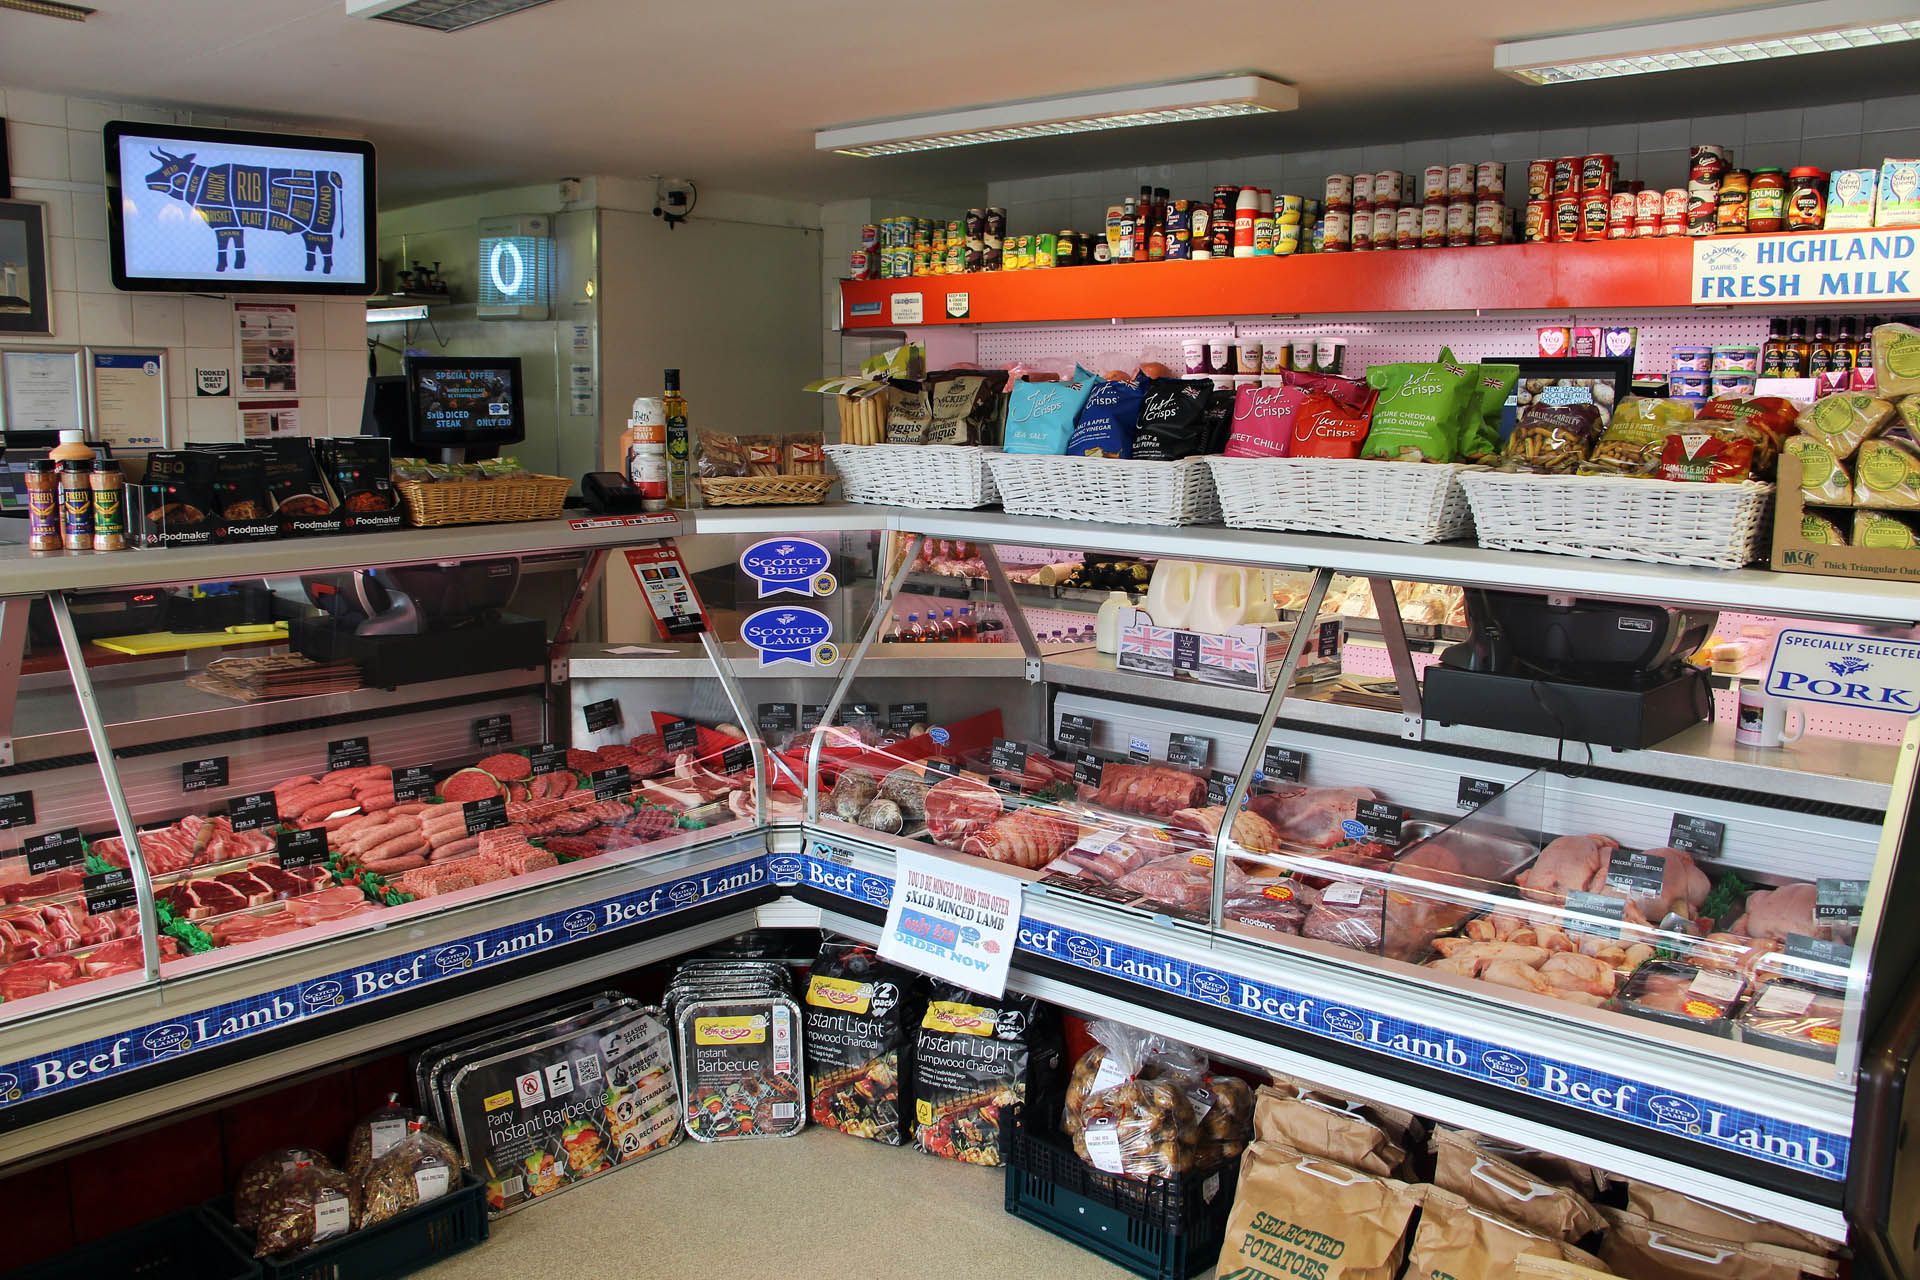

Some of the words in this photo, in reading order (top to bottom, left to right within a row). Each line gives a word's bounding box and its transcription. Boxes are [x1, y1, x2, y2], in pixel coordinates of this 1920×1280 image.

[206, 172, 226, 202] CHUCK
[237, 170, 262, 203] RIB
[1751, 189, 1780, 199] DOLMIO
[317, 185, 333, 226] ROUND
[1559, 204, 1580, 212] HEINZ
[1587, 201, 1606, 210] HEINZ
[241, 211, 263, 227] PLATE
[271, 215, 295, 232] FLANK
[1586, 213, 1606, 221] TOMATO
[218, 229, 241, 237] SHANK
[306, 233, 330, 242] SHANK
[1120, 226, 1131, 235] HP
[1701, 246, 1748, 262] CLAYMORE
[1756, 235, 1916, 265] HIGHLAND
[1710, 263, 1738, 272] DAIRIES
[1700, 273, 1801, 298] FRESH
[1818, 270, 1911, 296] MILK
[435, 371, 468, 380] SPECIAL
[1400, 383, 1443, 398] Crisps
[1544, 386, 1558, 394] NEW
[445, 410, 470, 419] DICED
[1033, 401, 1063, 419] Crisps
[1145, 406, 1178, 421] Crisps
[1254, 404, 1292, 418] Crisps
[1399, 411, 1436, 423] CHEDDAR
[435, 419, 462, 428] STEAK
[476, 418, 497, 427] ONLY
[1085, 424, 1112, 435] VINEGAR
[1091, 417, 1110, 427] APPLE
[1384, 418, 1398, 426] RED
[1398, 419, 1425, 428] ONION
[1029, 432, 1048, 440] SALT
[1315, 424, 1358, 438] Crisps
[1253, 437, 1284, 452] CHILLI
[151, 460, 185, 474] BBQ
[1662, 463, 1689, 473] TOMATO
[1696, 466, 1715, 476] BASIL
[293, 520, 341, 531] Foodmaker
[355, 516, 401, 526] Foodmaker
[158, 531, 211, 542] Foodmaker
[227, 524, 279, 536] Foodmaker
[748, 557, 822, 568] SCOTCH
[1823, 560, 1848, 571] Thick
[1850, 562, 1898, 575] Triangular
[762, 566, 809, 577] BEEF
[749, 626, 824, 638] SCOTCH
[760, 636, 812, 647] LAMB
[1784, 635, 1854, 653] SPECIALLY
[1857, 642, 1920, 661] SELECTE
[1773, 669, 1913, 707] PORK
[1342, 821, 1366, 834] SCOTCH
[700, 864, 765, 896] Lamb
[809, 861, 857, 893] Beef
[1614, 876, 1633, 885] £8.60
[907, 870, 920, 888] YOU
[933, 877, 954, 898] MINCED
[963, 885, 976, 906] MISS
[977, 889, 990, 909] THIS
[990, 895, 1010, 916] OFFER
[604, 889, 664, 927] Beef
[935, 899, 975, 922] MINCED
[976, 911, 1005, 931] LAMB
[1819, 907, 1847, 916] £17.90
[565, 916, 595, 929] SCOTCH
[474, 922, 554, 963] Lamb
[1018, 927, 1060, 953] eef
[436, 948, 469, 963] SCOTCH
[894, 931, 946, 959] ORDER
[950, 950, 990, 973] NOW
[1069, 938, 1099, 958] SCOTCH
[1102, 944, 1182, 988] Lamb
[352, 955, 427, 998] Beef
[1194, 975, 1228, 993] SCOTCH
[304, 985, 340, 1001] SCOTCH
[878, 984, 891, 997] 2
[874, 995, 895, 1009] pack
[1238, 981, 1315, 1025] Beef
[193, 998, 295, 1044] Lamb
[1003, 1010, 1016, 1025] 2
[1323, 1009, 1363, 1028] SCOTCH
[1330, 1017, 1355, 1030] LAMB
[623, 1022, 649, 1040] SEASIDE
[845, 1015, 885, 1039] Light
[146, 1030, 185, 1047] SCOTCH
[625, 1029, 648, 1046] SAFETY
[841, 1035, 879, 1049] Charcoal
[1367, 1017, 1468, 1068] Lamb
[696, 1049, 728, 1058] Instant
[917, 1031, 966, 1054] Instant
[970, 1035, 1014, 1062] Light
[32, 1037, 131, 1091] Beef
[627, 1051, 659, 1072] BARBECUE
[697, 1059, 760, 1073] Barbecue
[916, 1053, 966, 1070] Lumpwood
[965, 1058, 1007, 1075] Charcoal
[1484, 1054, 1526, 1073] SCOTCH
[1491, 1061, 1517, 1075] BEEF
[629, 1063, 652, 1079] SAFELY
[634, 1082, 673, 1109] SUSTAINABLE
[1539, 1062, 1637, 1115] Beef
[1651, 1101, 1698, 1121] SCOTCH
[1658, 1109, 1689, 1122] LAMB
[487, 1109, 515, 1129] Party
[489, 1116, 542, 1147] Instant
[542, 1091, 610, 1127] Barbecue
[638, 1114, 675, 1140] RECYCLABLE
[1707, 1110, 1837, 1169] Lamb
[1250, 1210, 1346, 1260] SELECTED
[1238, 1233, 1329, 1280] POTATOES
